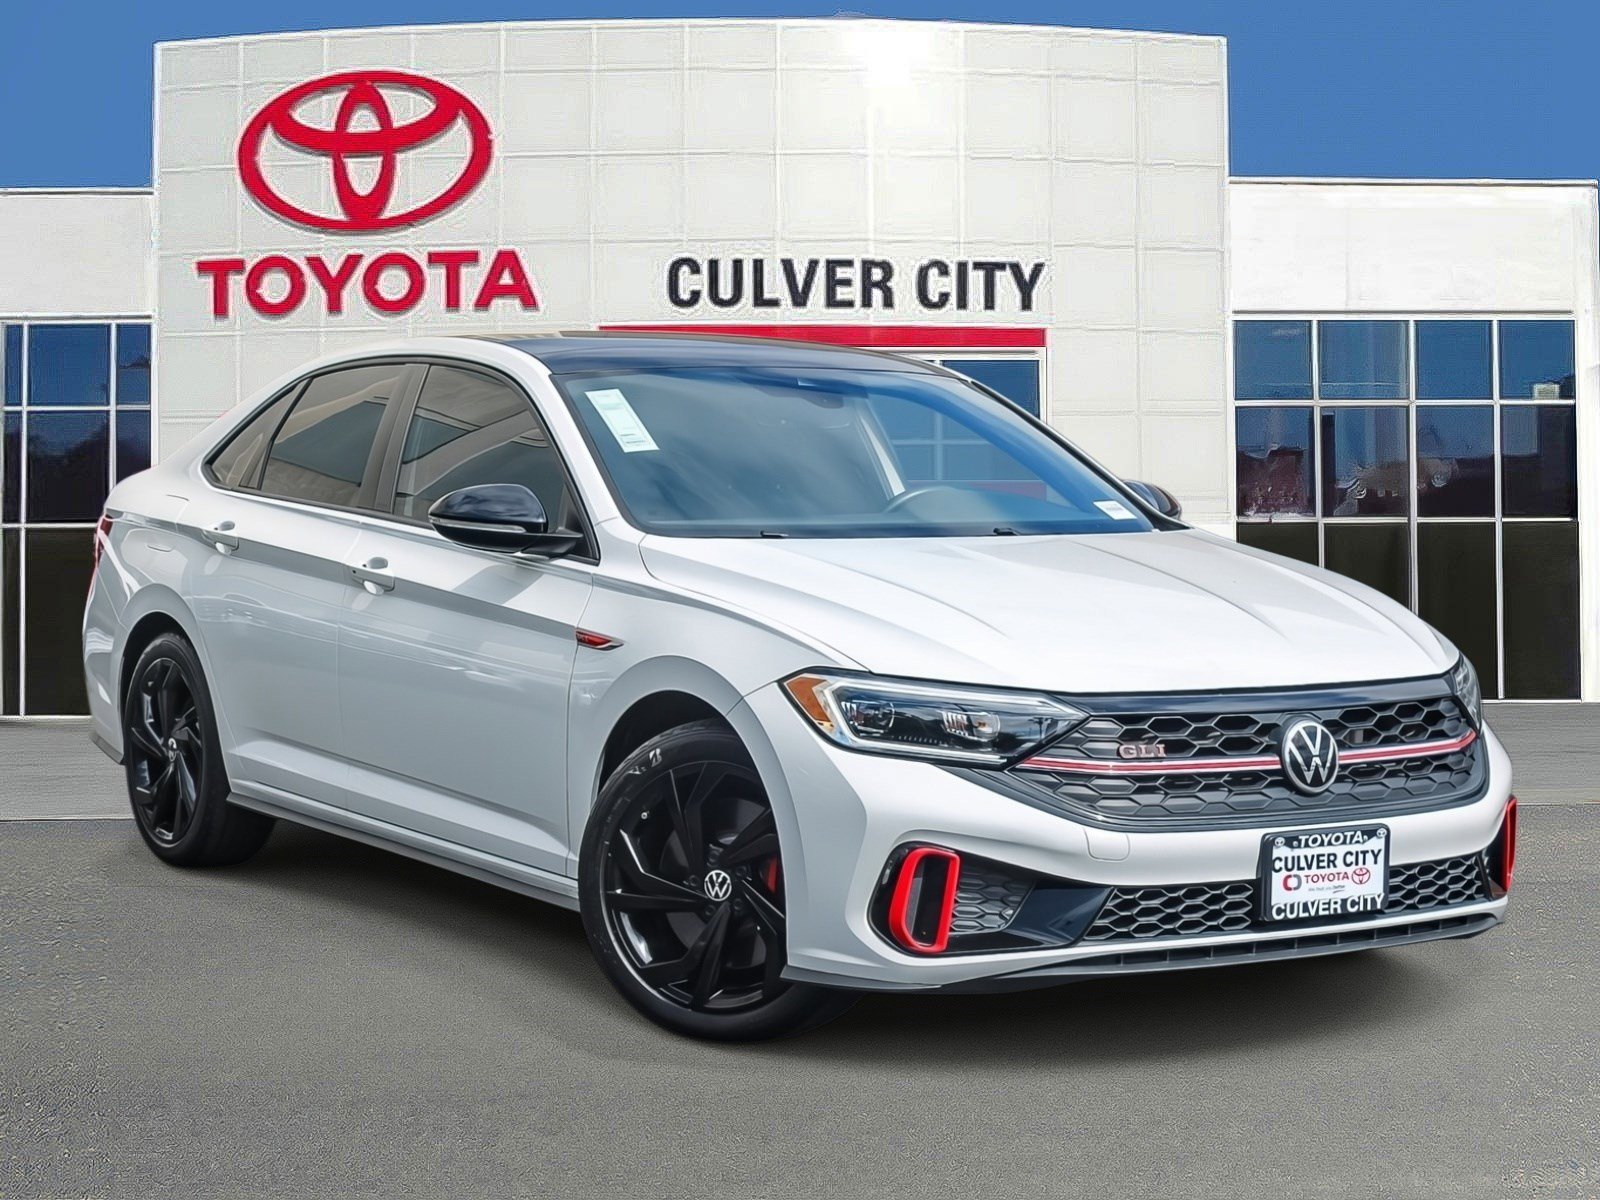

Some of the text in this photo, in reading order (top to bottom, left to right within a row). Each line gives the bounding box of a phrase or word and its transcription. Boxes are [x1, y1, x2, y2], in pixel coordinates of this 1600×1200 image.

[195, 249, 540, 319] TOYOTA
[667, 258, 1046, 311] CULVER CITY
[1118, 744, 1167, 759] GLI
[1299, 831, 1363, 848] TOYOTA
[1272, 849, 1382, 873] CULVER CITY
[1304, 871, 1350, 884] TOYOTA
[1272, 893, 1385, 920] CULVER CITY
